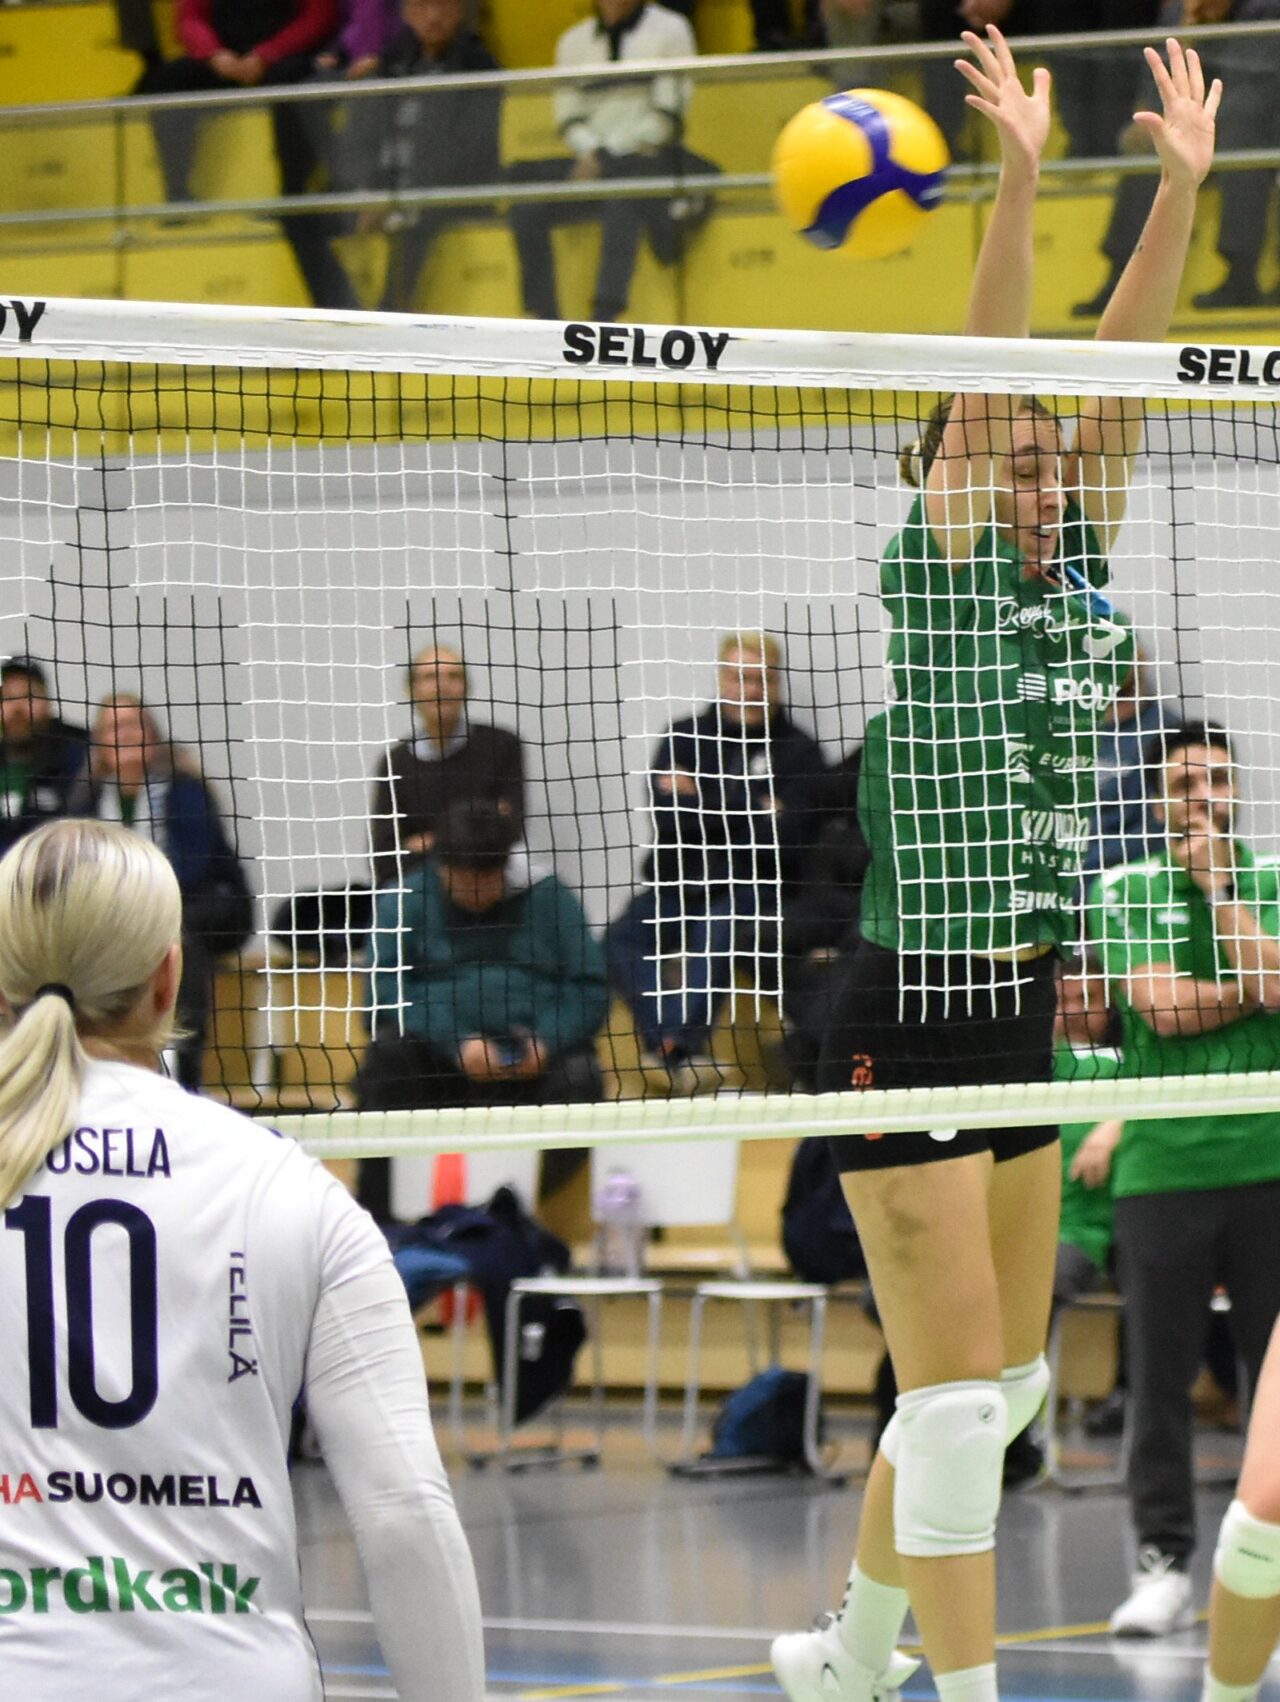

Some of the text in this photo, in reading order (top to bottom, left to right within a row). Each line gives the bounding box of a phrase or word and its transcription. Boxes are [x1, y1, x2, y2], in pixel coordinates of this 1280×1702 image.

[563, 324, 729, 370] SELOY
[36, 1127, 171, 1179] USELA
[5, 1195, 159, 1430] 10
